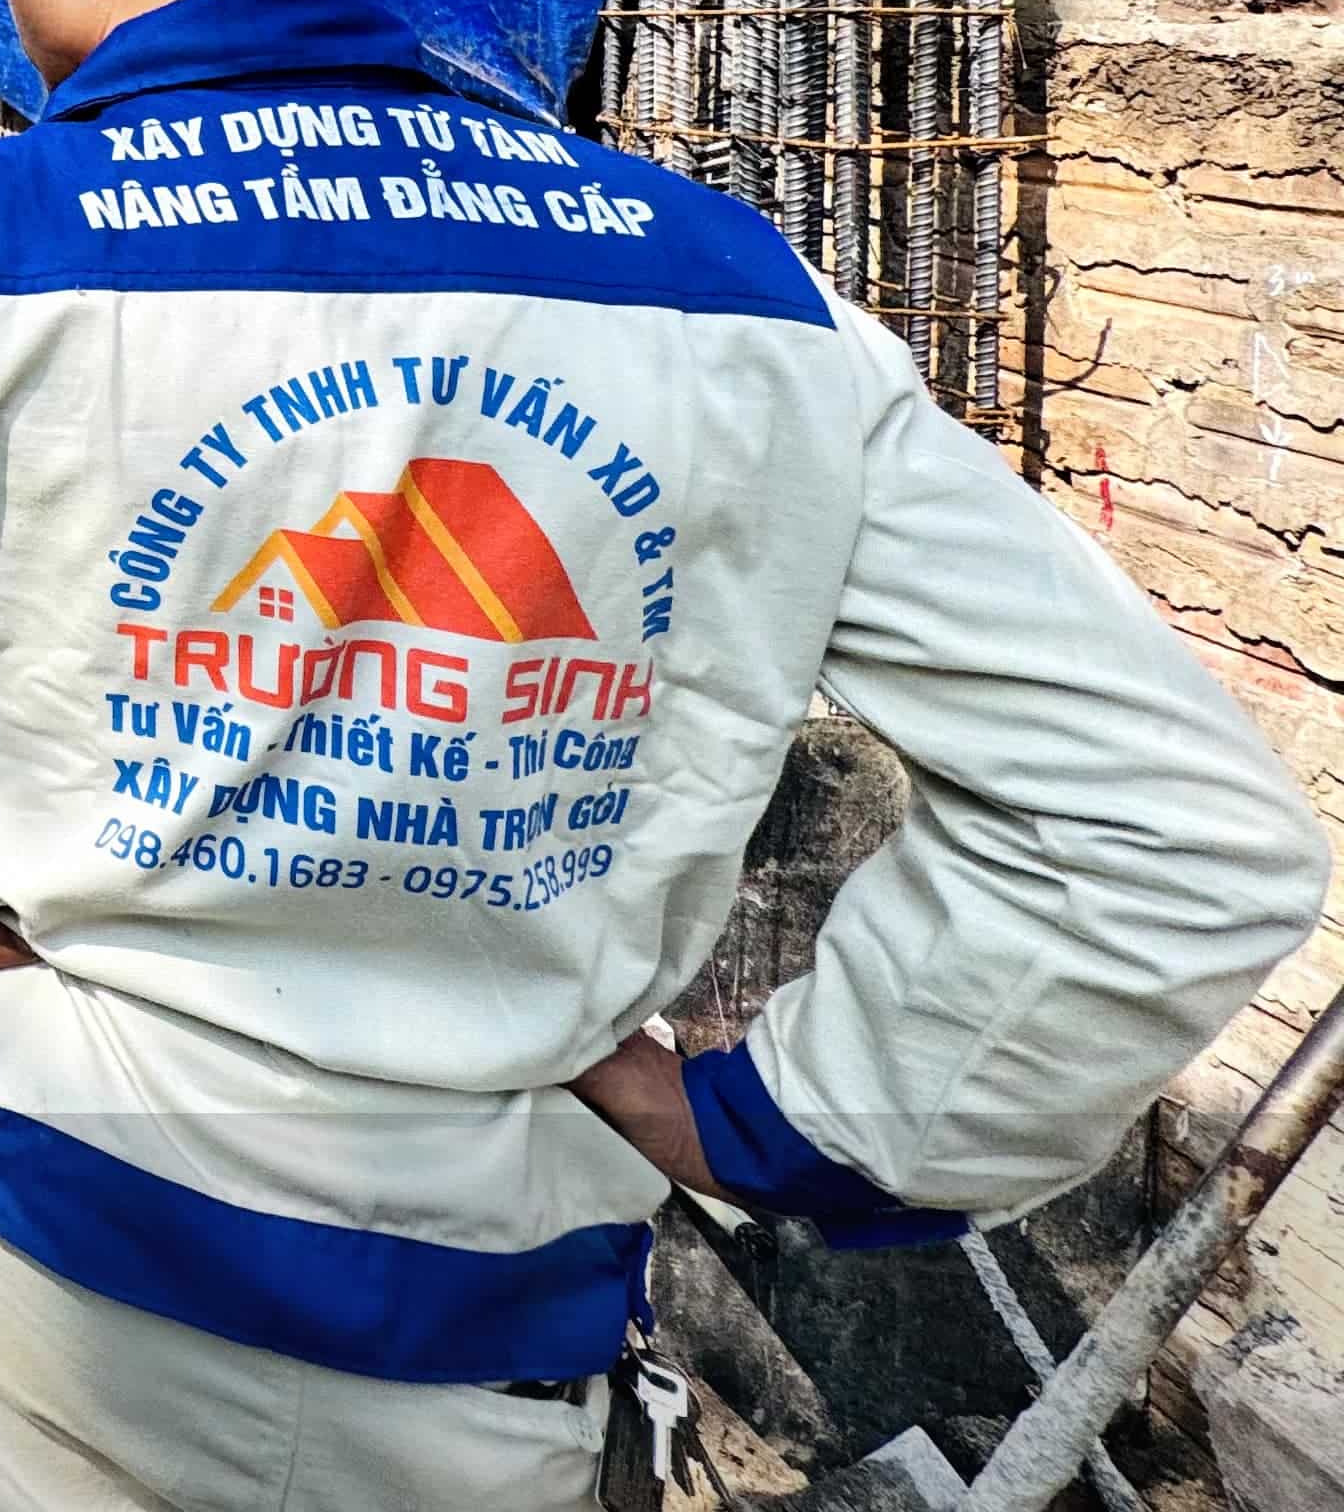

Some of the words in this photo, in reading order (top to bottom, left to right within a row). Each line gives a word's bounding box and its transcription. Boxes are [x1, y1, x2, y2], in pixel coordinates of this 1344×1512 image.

[101, 118, 204, 161] XÂY
[220, 102, 381, 157] DỰNG
[387, 104, 455, 152] TỪ
[461, 118, 579, 168] TÂM
[78, 179, 239, 230] NÂNG
[243, 163, 370, 220] TẦM
[380, 158, 539, 228] ĐẲNG
[544, 181, 654, 237] CẤP
[242, 359, 378, 442] TNHH
[392, 355, 469, 405] TƯ
[480, 368, 597, 460] VẤN
[179, 422, 248, 488] TY
[587, 442, 660, 517] XD
[108, 488, 204, 611] CÔNG
[634, 526, 676, 566] &
[642, 567, 673, 643] TM
[116, 624, 469, 724] TRƯỜNG
[501, 656, 653, 725] SINH
[106, 694, 159, 738] Tư
[172, 702, 251, 762] Vấn
[410, 731, 477, 782] Kế
[510, 729, 548, 780] Thi
[553, 729, 640, 772] Công
[112, 758, 200, 816] XÂY
[208, 773, 336, 835] DỰNG
[357, 796, 458, 848] NHÀ
[568, 783, 630, 830] GÓI
[94, 817, 369, 889] 098.460.1683
[403, 844, 612, 911] 0975.258.999
